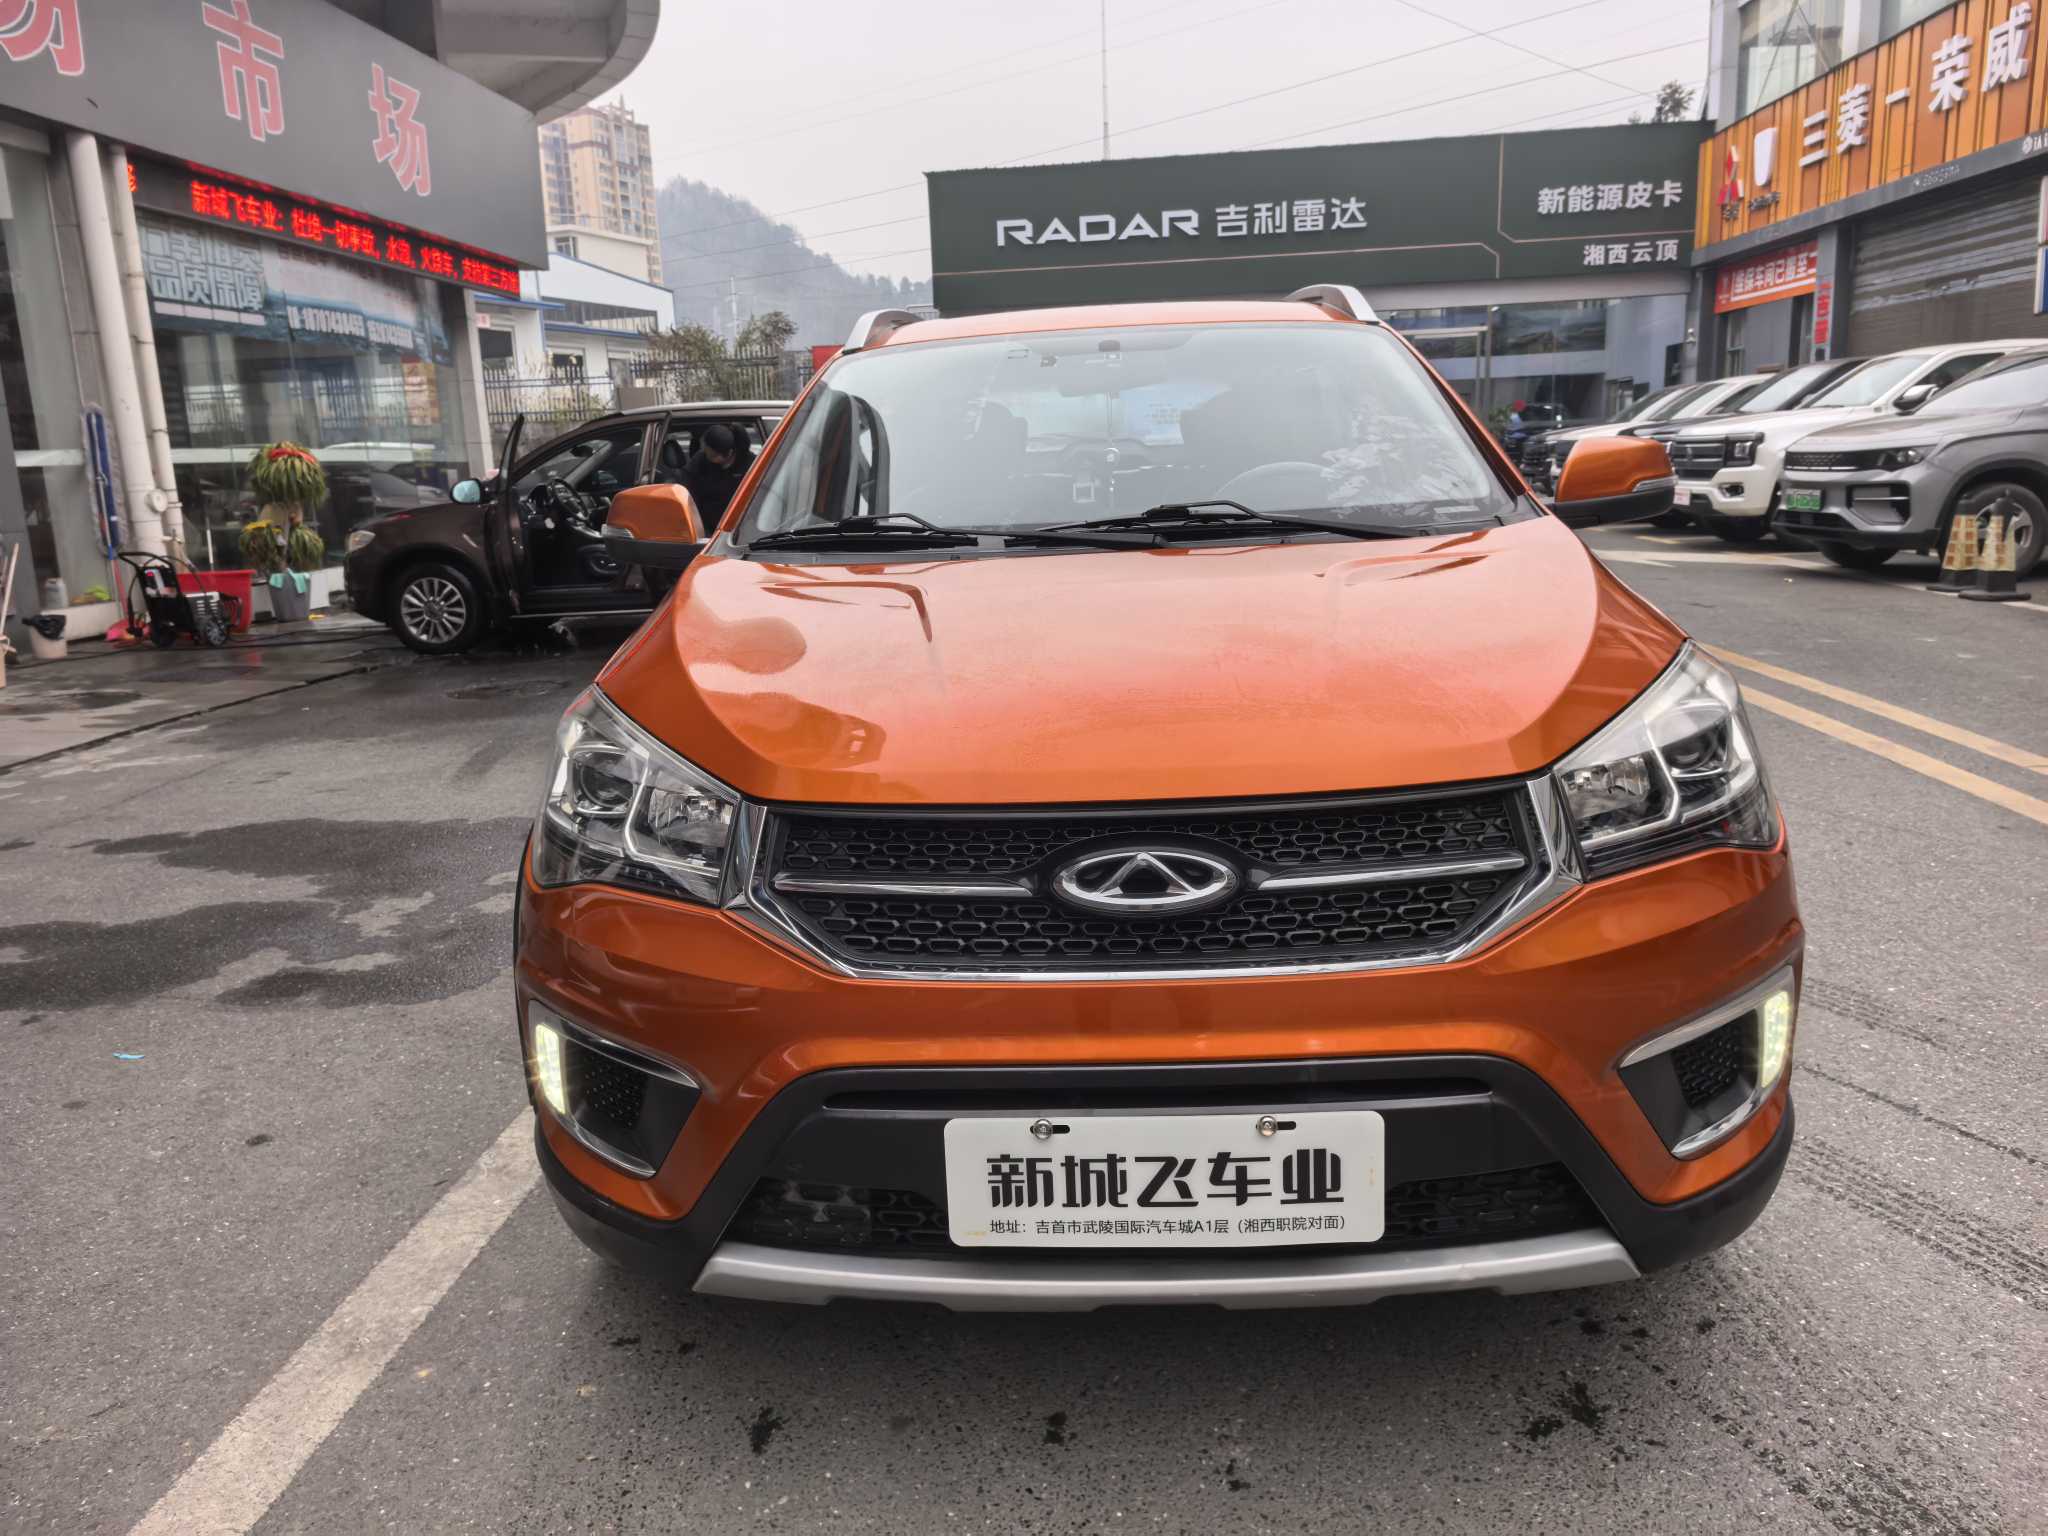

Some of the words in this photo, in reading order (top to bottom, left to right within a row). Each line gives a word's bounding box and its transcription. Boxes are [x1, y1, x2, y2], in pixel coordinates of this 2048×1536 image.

[1537, 180, 1683, 215] 新能源皮卡
[996, 208, 1200, 247] RADAR
[1214, 196, 1368, 237] 吉利雷达
[1583, 239, 1680, 266] 湘西云顶
[986, 1148, 1345, 1208] 新城飞车业
